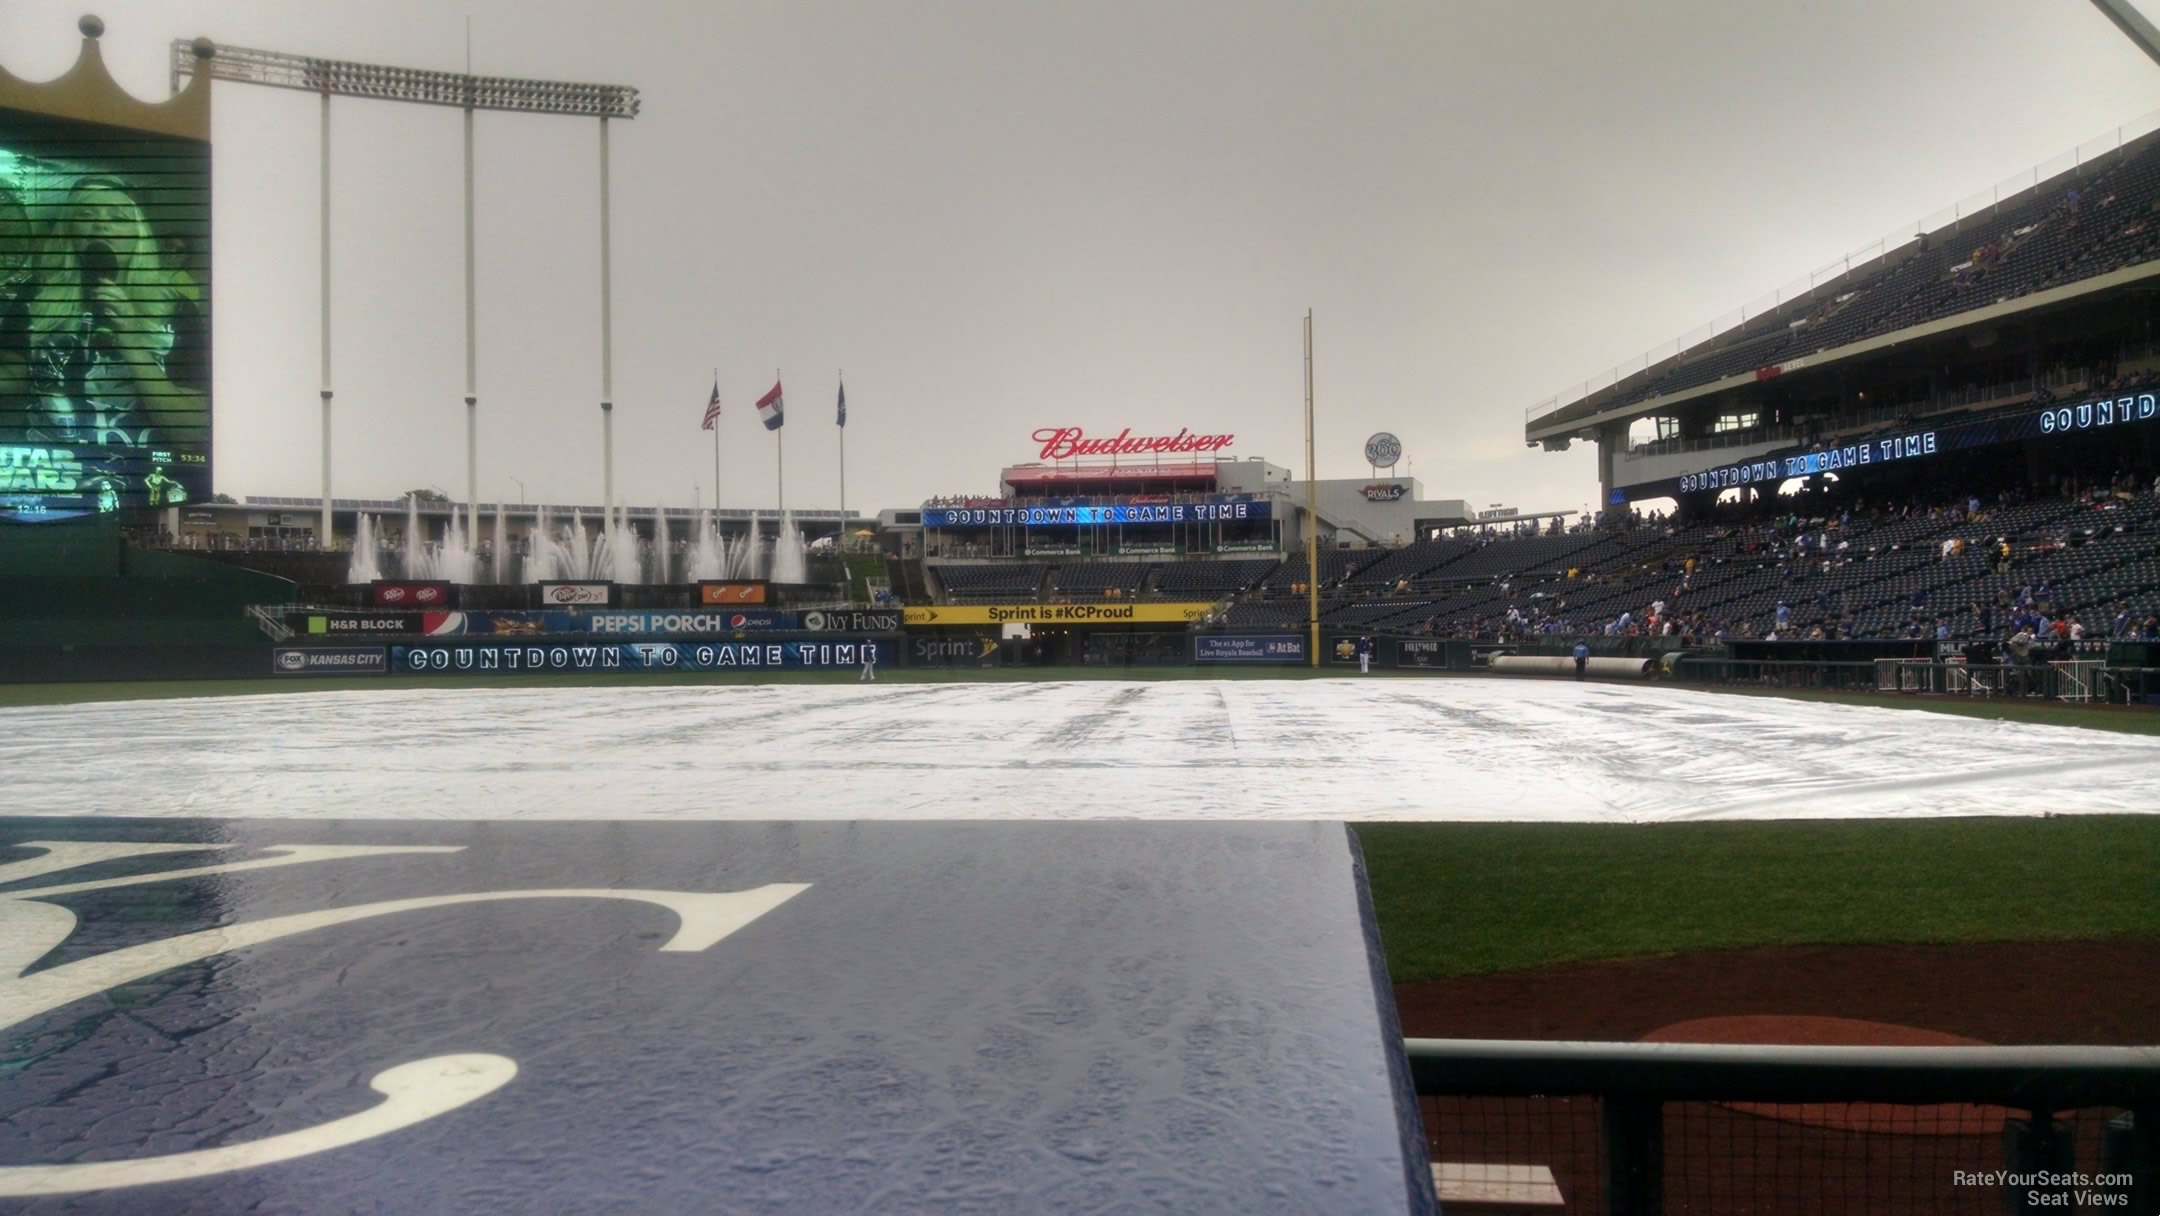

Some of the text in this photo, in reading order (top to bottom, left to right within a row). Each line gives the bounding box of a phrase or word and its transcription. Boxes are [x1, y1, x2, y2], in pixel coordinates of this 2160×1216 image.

[2040, 394, 2156, 434] COUNTD
[1032, 426, 1235, 460] Budweiser
[1679, 432, 1936, 493] COUNTDOWN TO GAME TIME
[1367, 488, 1400, 499] RIVALS
[18, 504, 47, 514] 12:16
[946, 504, 1248, 525] COUNTDOWN TO GAME TIME
[1161, 546, 1176, 554] Bank
[904, 612, 926, 622] print
[988, 605, 1134, 622] Sprint is #KCProud
[330, 620, 404, 630] H&R BLOCK
[592, 614, 721, 632] PEPSI PORCH
[747, 617, 772, 627] pepsi
[826, 613, 898, 631] IVY FUNDS
[915, 637, 974, 661] Sprint
[1209, 640, 1222, 648] The
[1231, 640, 1245, 649] App
[1245, 640, 1256, 648] for
[1276, 642, 1301, 653] At Bat
[1404, 642, 1438, 652] HOLLYWOOD
[408, 644, 877, 670] COUNTDOWN TO GAME TIME
[1200, 648, 1264, 658] Live Royals Baseball
[284, 653, 384, 666] FOX KANSAS CITY
